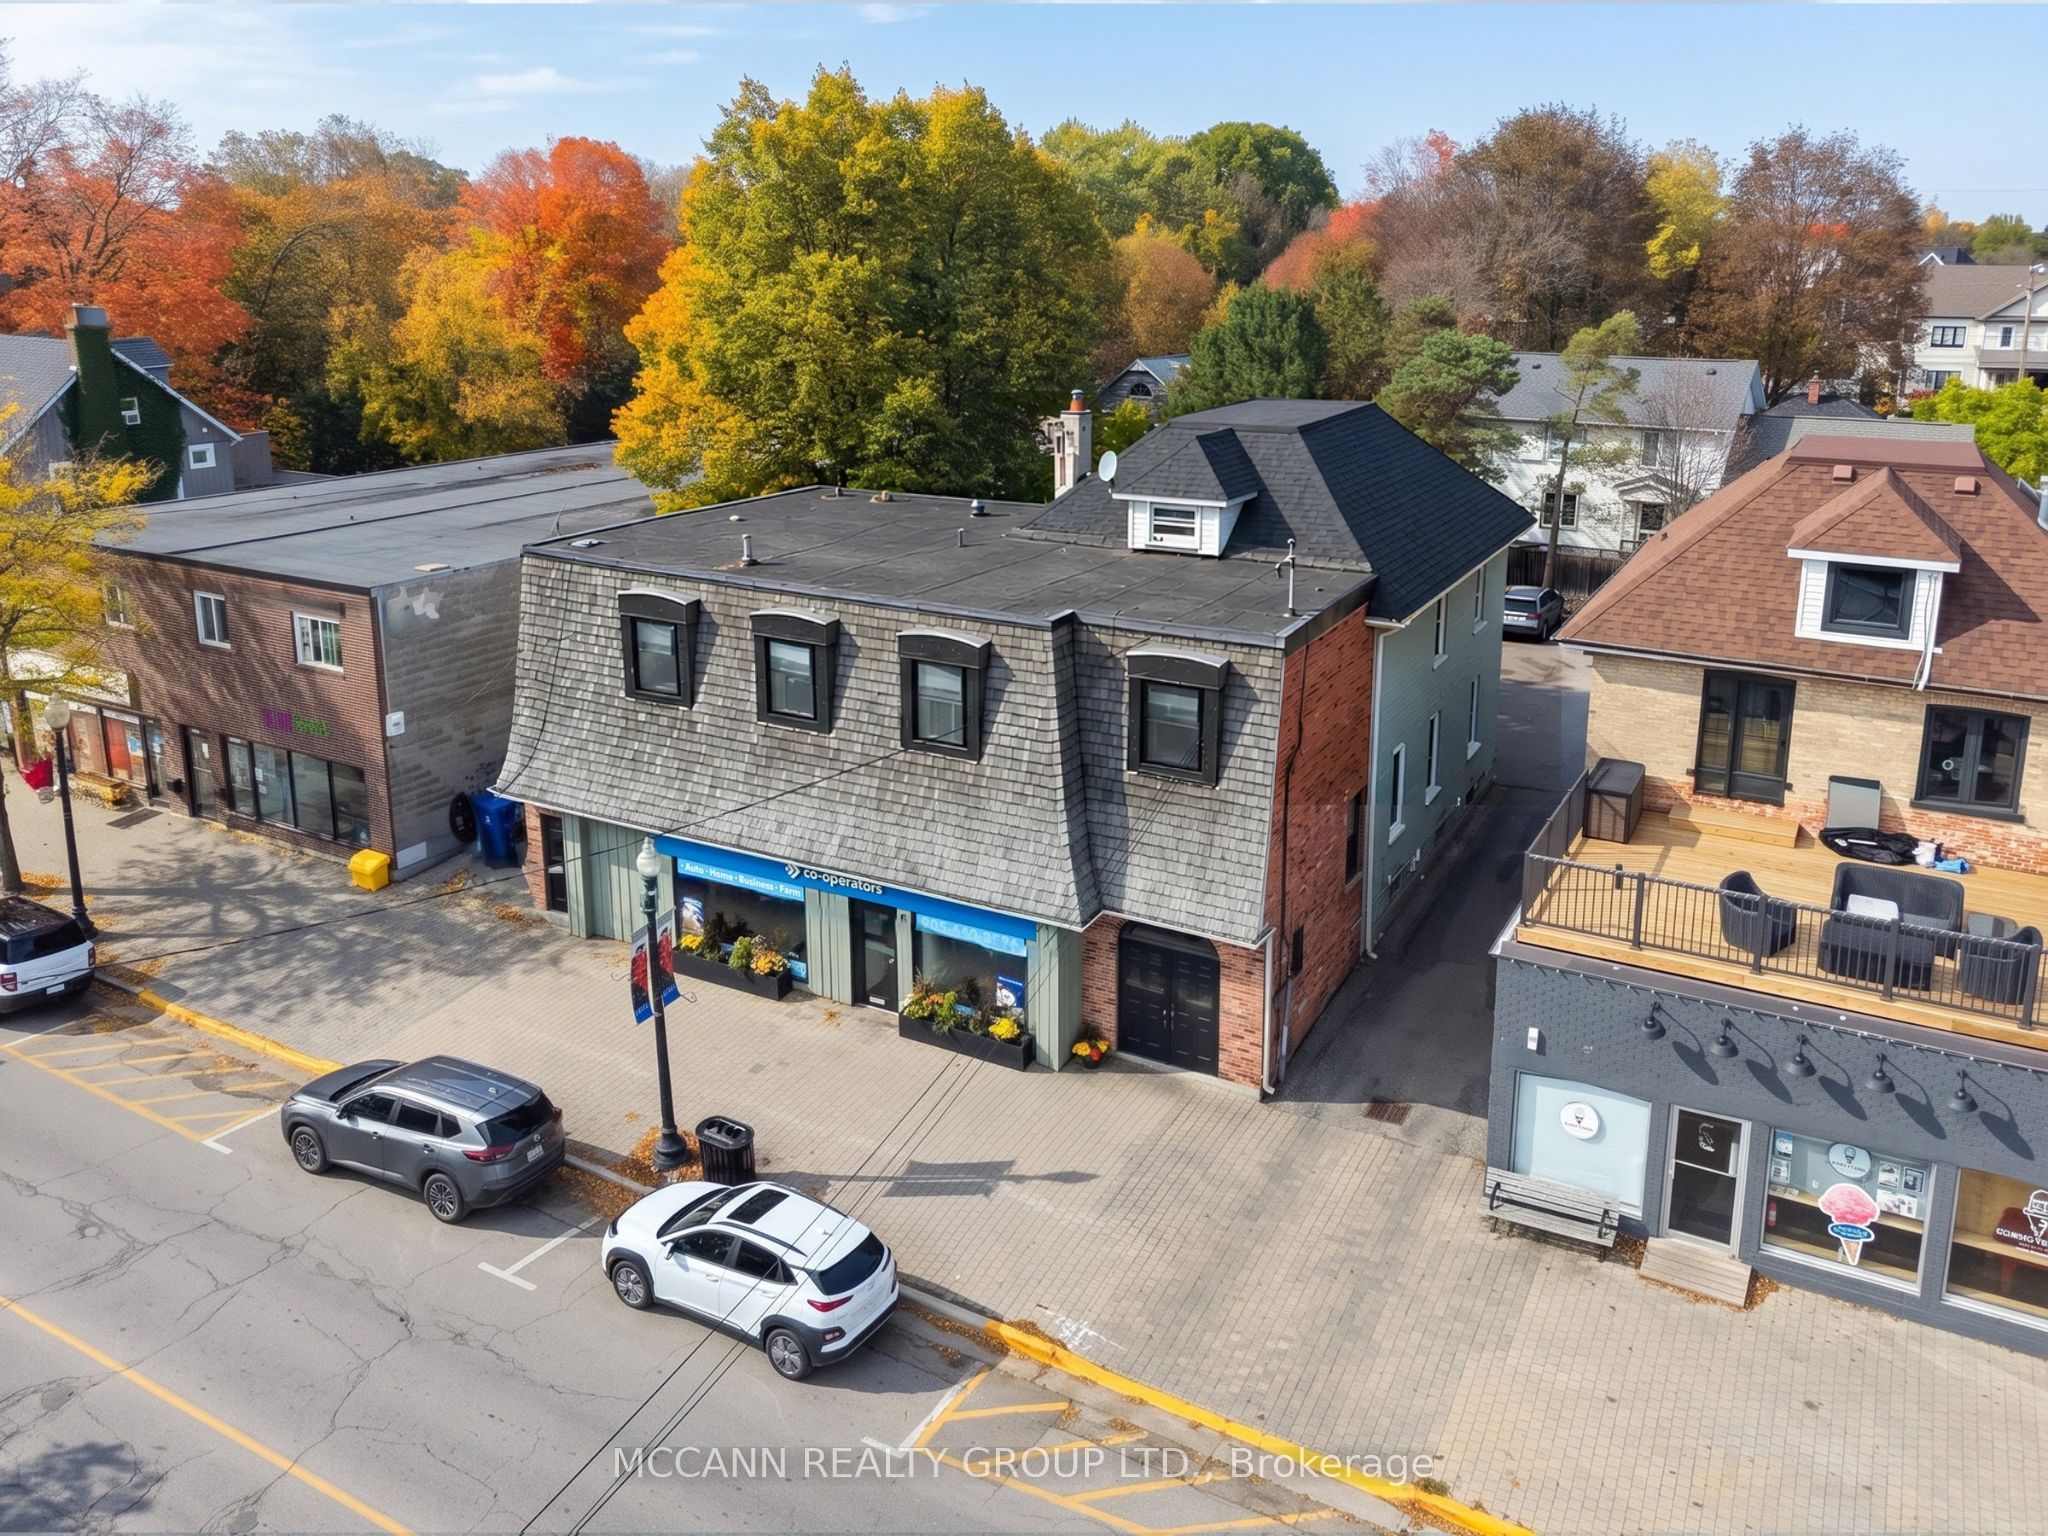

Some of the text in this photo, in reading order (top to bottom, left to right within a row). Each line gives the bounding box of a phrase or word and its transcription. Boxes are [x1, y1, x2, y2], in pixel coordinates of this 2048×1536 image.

[685, 862, 802, 897] Auto Home Business Farm
[803, 869, 883, 895] co-operators
